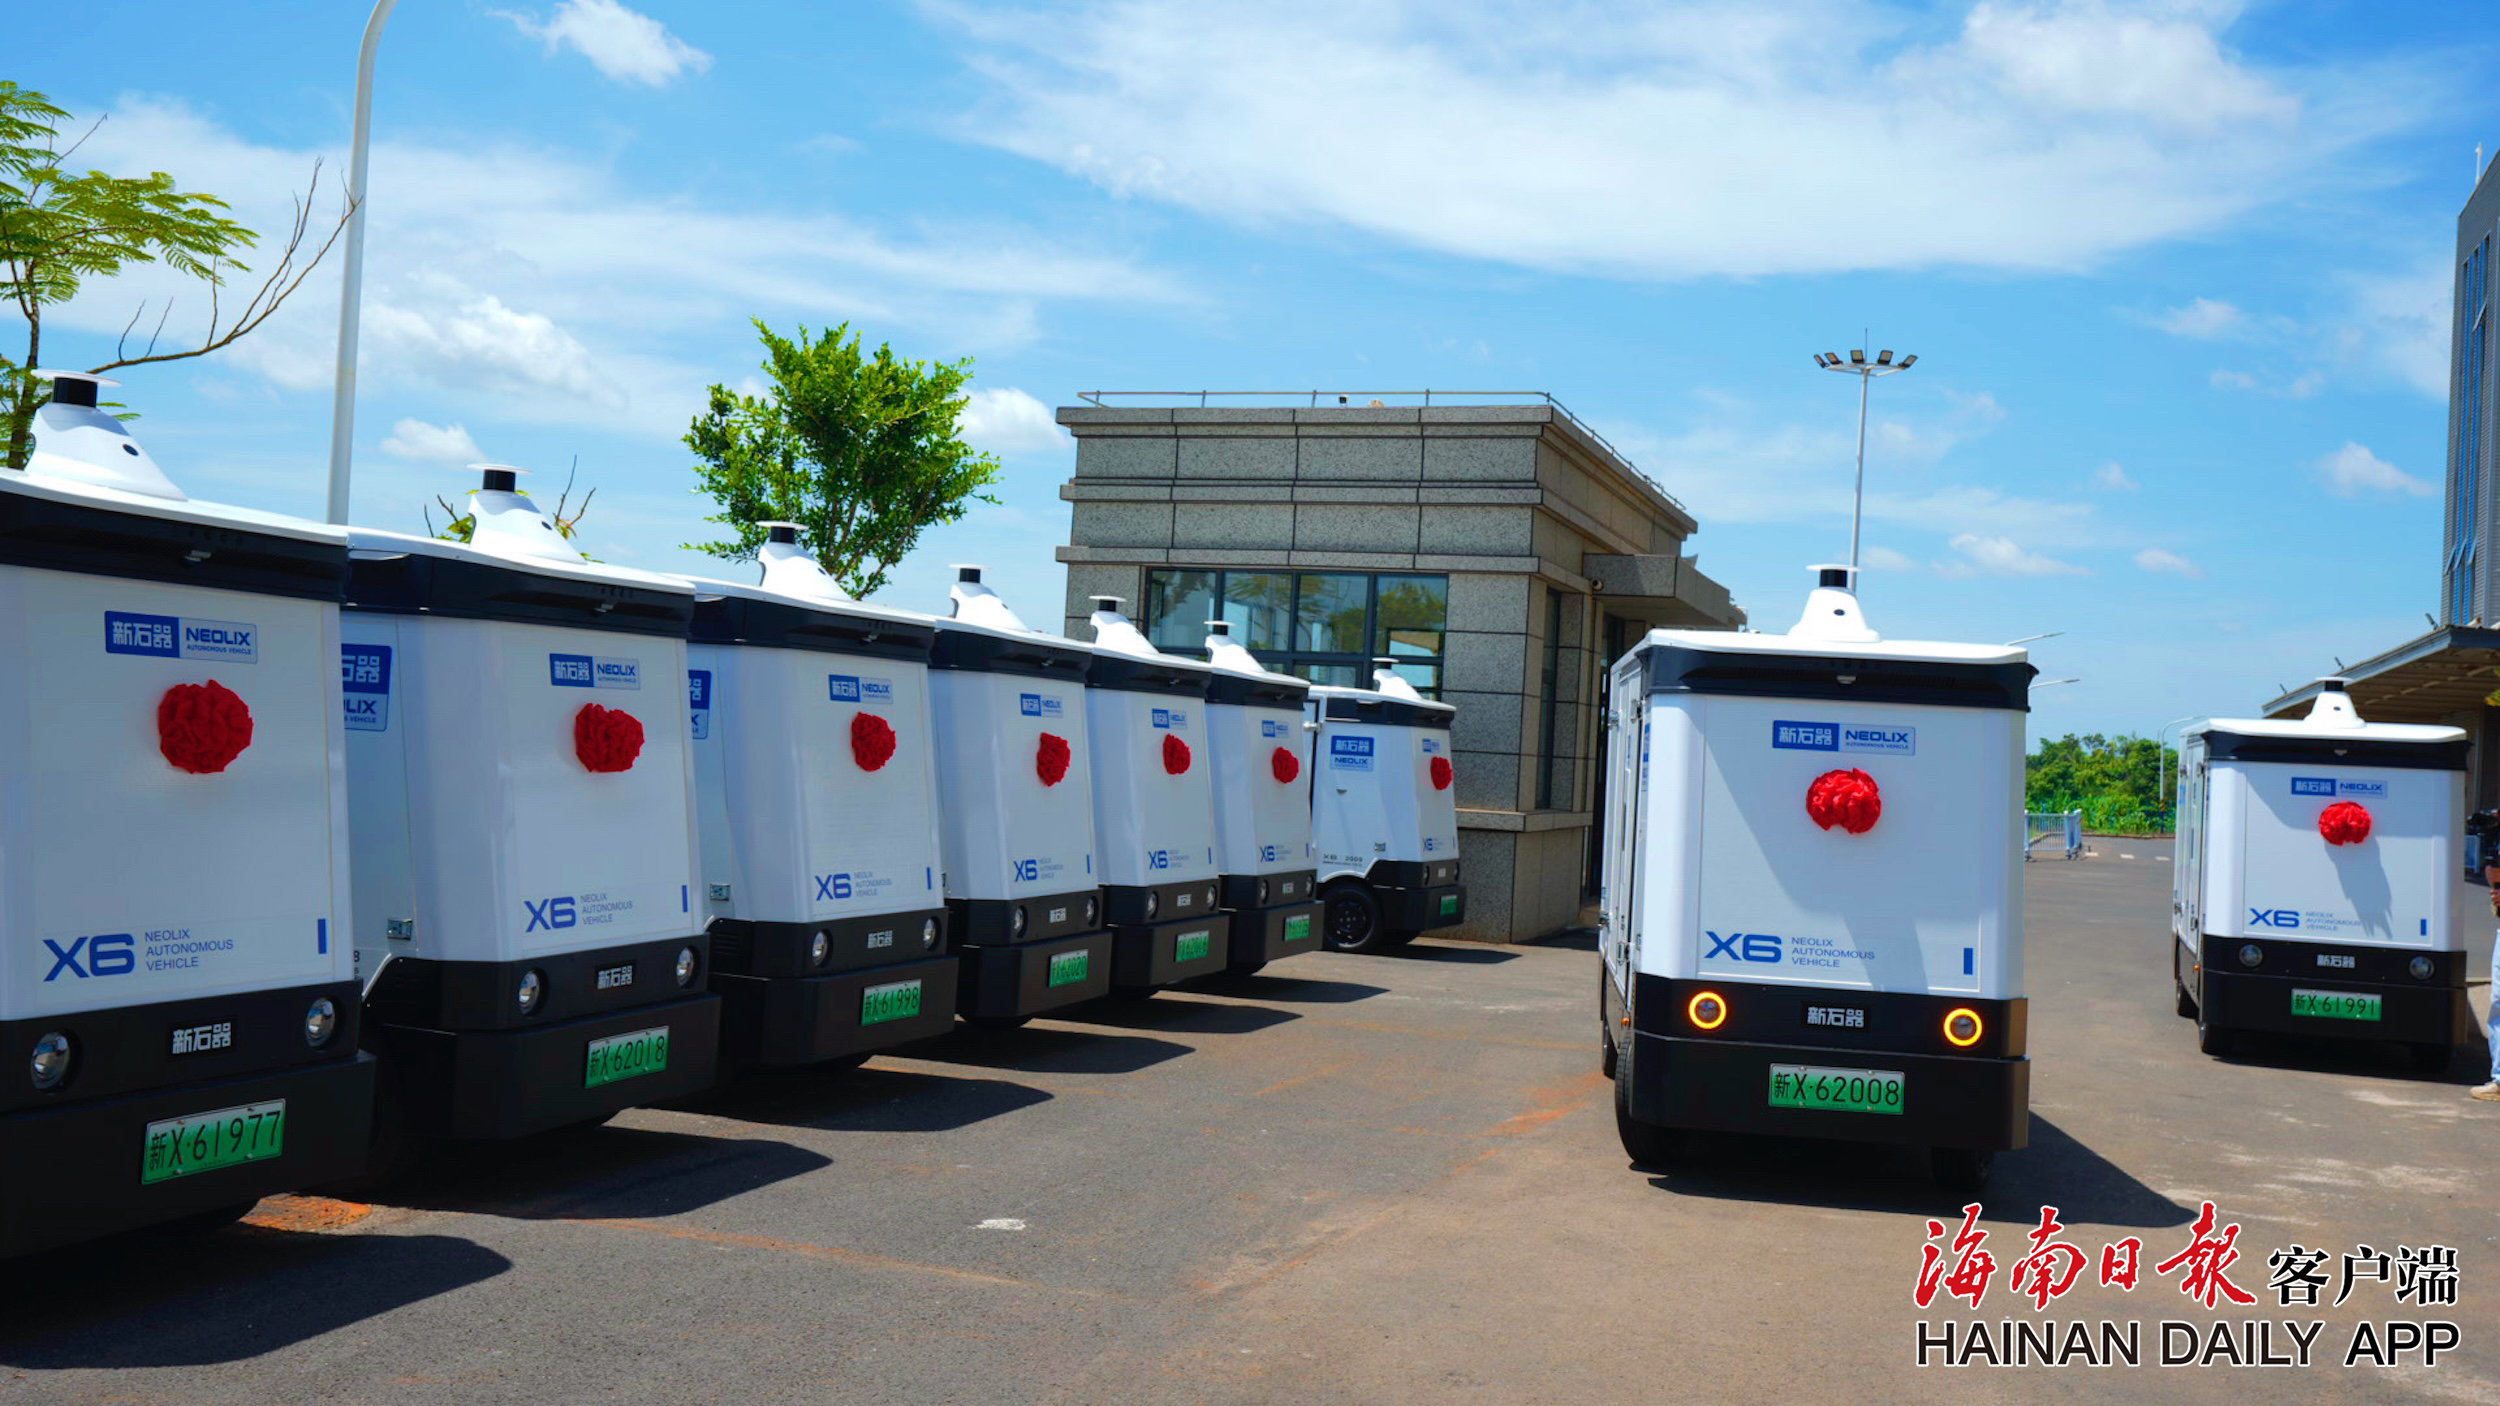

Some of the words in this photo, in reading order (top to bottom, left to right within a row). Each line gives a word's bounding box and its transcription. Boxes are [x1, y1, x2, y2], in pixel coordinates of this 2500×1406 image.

[113, 621, 172, 649] 新石器
[186, 627, 250, 645] NEOLIX
[187, 644, 227, 653] AUTONOMOUS
[229, 647, 252, 655] VEHICLE
[554, 661, 590, 680] 新石器
[597, 664, 636, 676] NEOLIX
[862, 684, 890, 693] NEOLIX
[344, 699, 377, 714] LIX
[1779, 727, 1832, 745] 新石器
[1845, 730, 1908, 743] NEOLIX
[1846, 741, 1884, 749] AUTONOMOUS
[2340, 782, 2383, 791] NEOLIX
[1148, 850, 1168, 870] X6
[1260, 845, 1275, 862] X6
[1013, 859, 1037, 882] X6
[815, 873, 852, 901] X6
[581, 893, 608, 903] NEOLIX
[523, 896, 576, 933] X6
[582, 901, 633, 914] AUTONOMOUS
[583, 914, 614, 925] VEHICLE
[2249, 908, 2300, 928] X6
[2305, 918, 2361, 927] AUTONOMOUS
[145, 928, 190, 942] NEOLIX
[1791, 937, 1834, 947] NEOLIX
[146, 939, 234, 957] AUTONOMOUS
[1704, 931, 1782, 963] X6
[1791, 947, 1875, 960] AUTONOMOUS
[43, 933, 135, 982] X6
[146, 956, 199, 971] VEHICLE
[1791, 957, 1840, 968] VEHICLE
[597, 965, 633, 989] 新石器
[1807, 1006, 1865, 1028] 新石器
[172, 1022, 231, 1055] 新石器
